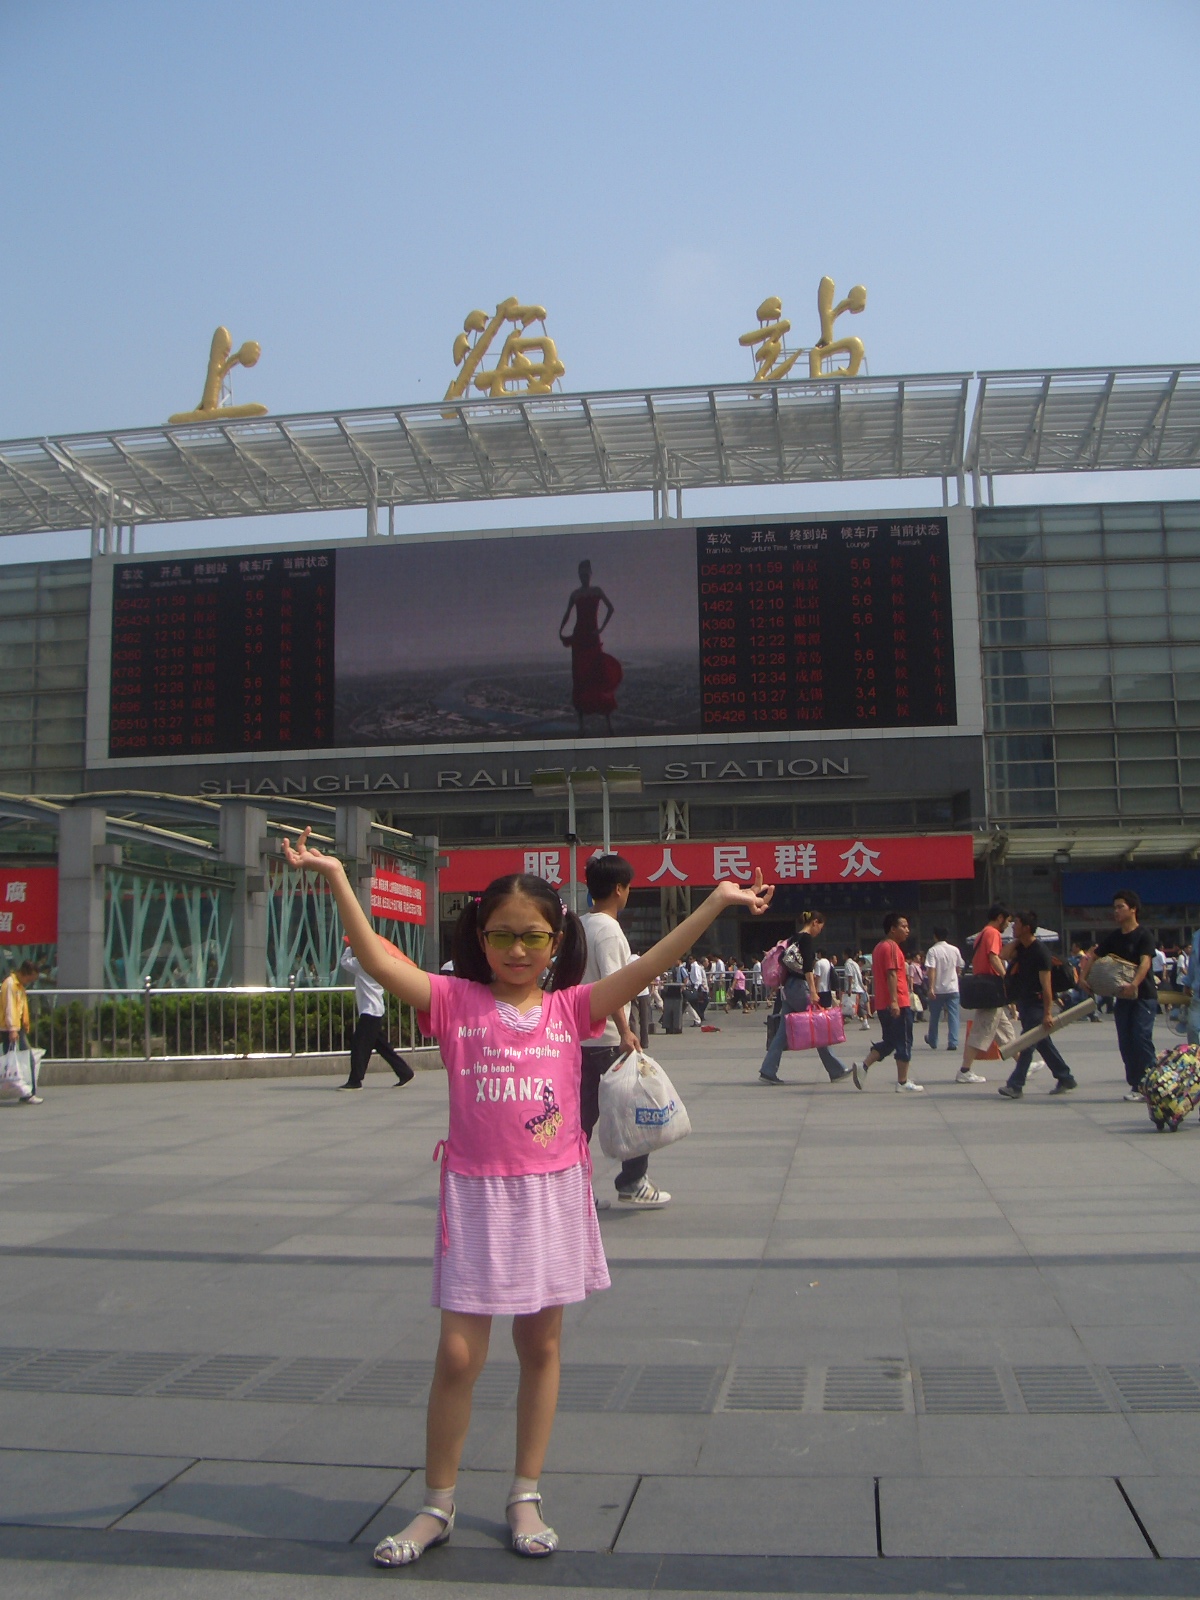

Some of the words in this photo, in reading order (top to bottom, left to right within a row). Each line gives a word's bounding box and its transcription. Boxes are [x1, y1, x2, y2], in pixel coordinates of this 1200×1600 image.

[708, 533, 732, 545] 车次
[751, 530, 776, 542] 开点
[790, 528, 828, 540] 终到站
[841, 526, 878, 539] 候车厅
[890, 524, 940, 537] 当前状态
[703, 637, 736, 649] K782
[199, 771, 410, 795] SHANGHAI
[664, 757, 848, 780] STATION
[523, 841, 882, 885] 服人民群众
[458, 1026, 487, 1038] Merry
[483, 1046, 501, 1058] They
[504, 1047, 522, 1059] play
[524, 1045, 560, 1058] together
[460, 1068, 470, 1076] on
[474, 1062, 488, 1074] the
[491, 1062, 514, 1073] beach
